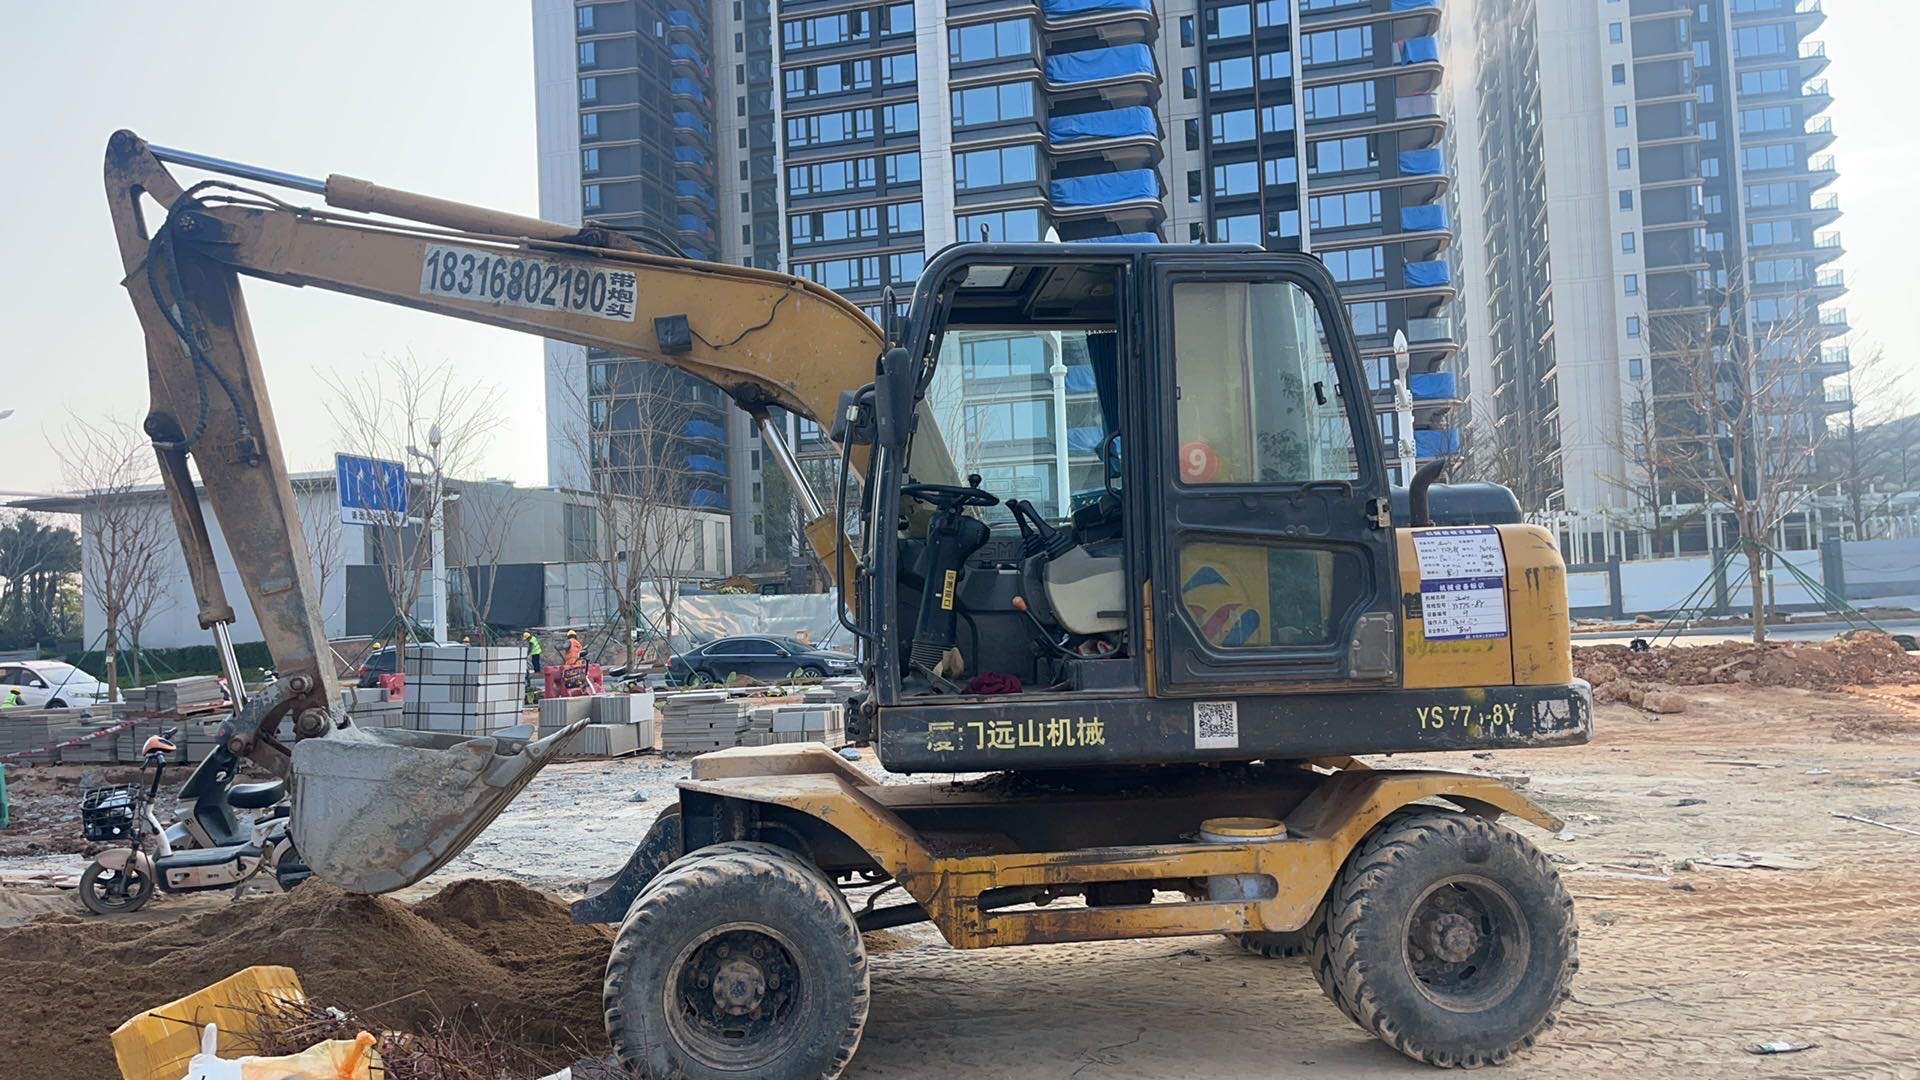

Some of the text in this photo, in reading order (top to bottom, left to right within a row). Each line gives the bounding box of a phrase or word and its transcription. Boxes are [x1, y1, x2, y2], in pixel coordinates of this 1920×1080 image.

[427, 249, 606, 313] 18316802190
[605, 271, 636, 319] 带炮头
[1188, 448, 1207, 476] 9
[1439, 582, 1486, 592] 机械设备标识
[1416, 702, 1517, 729] YS77-8Y
